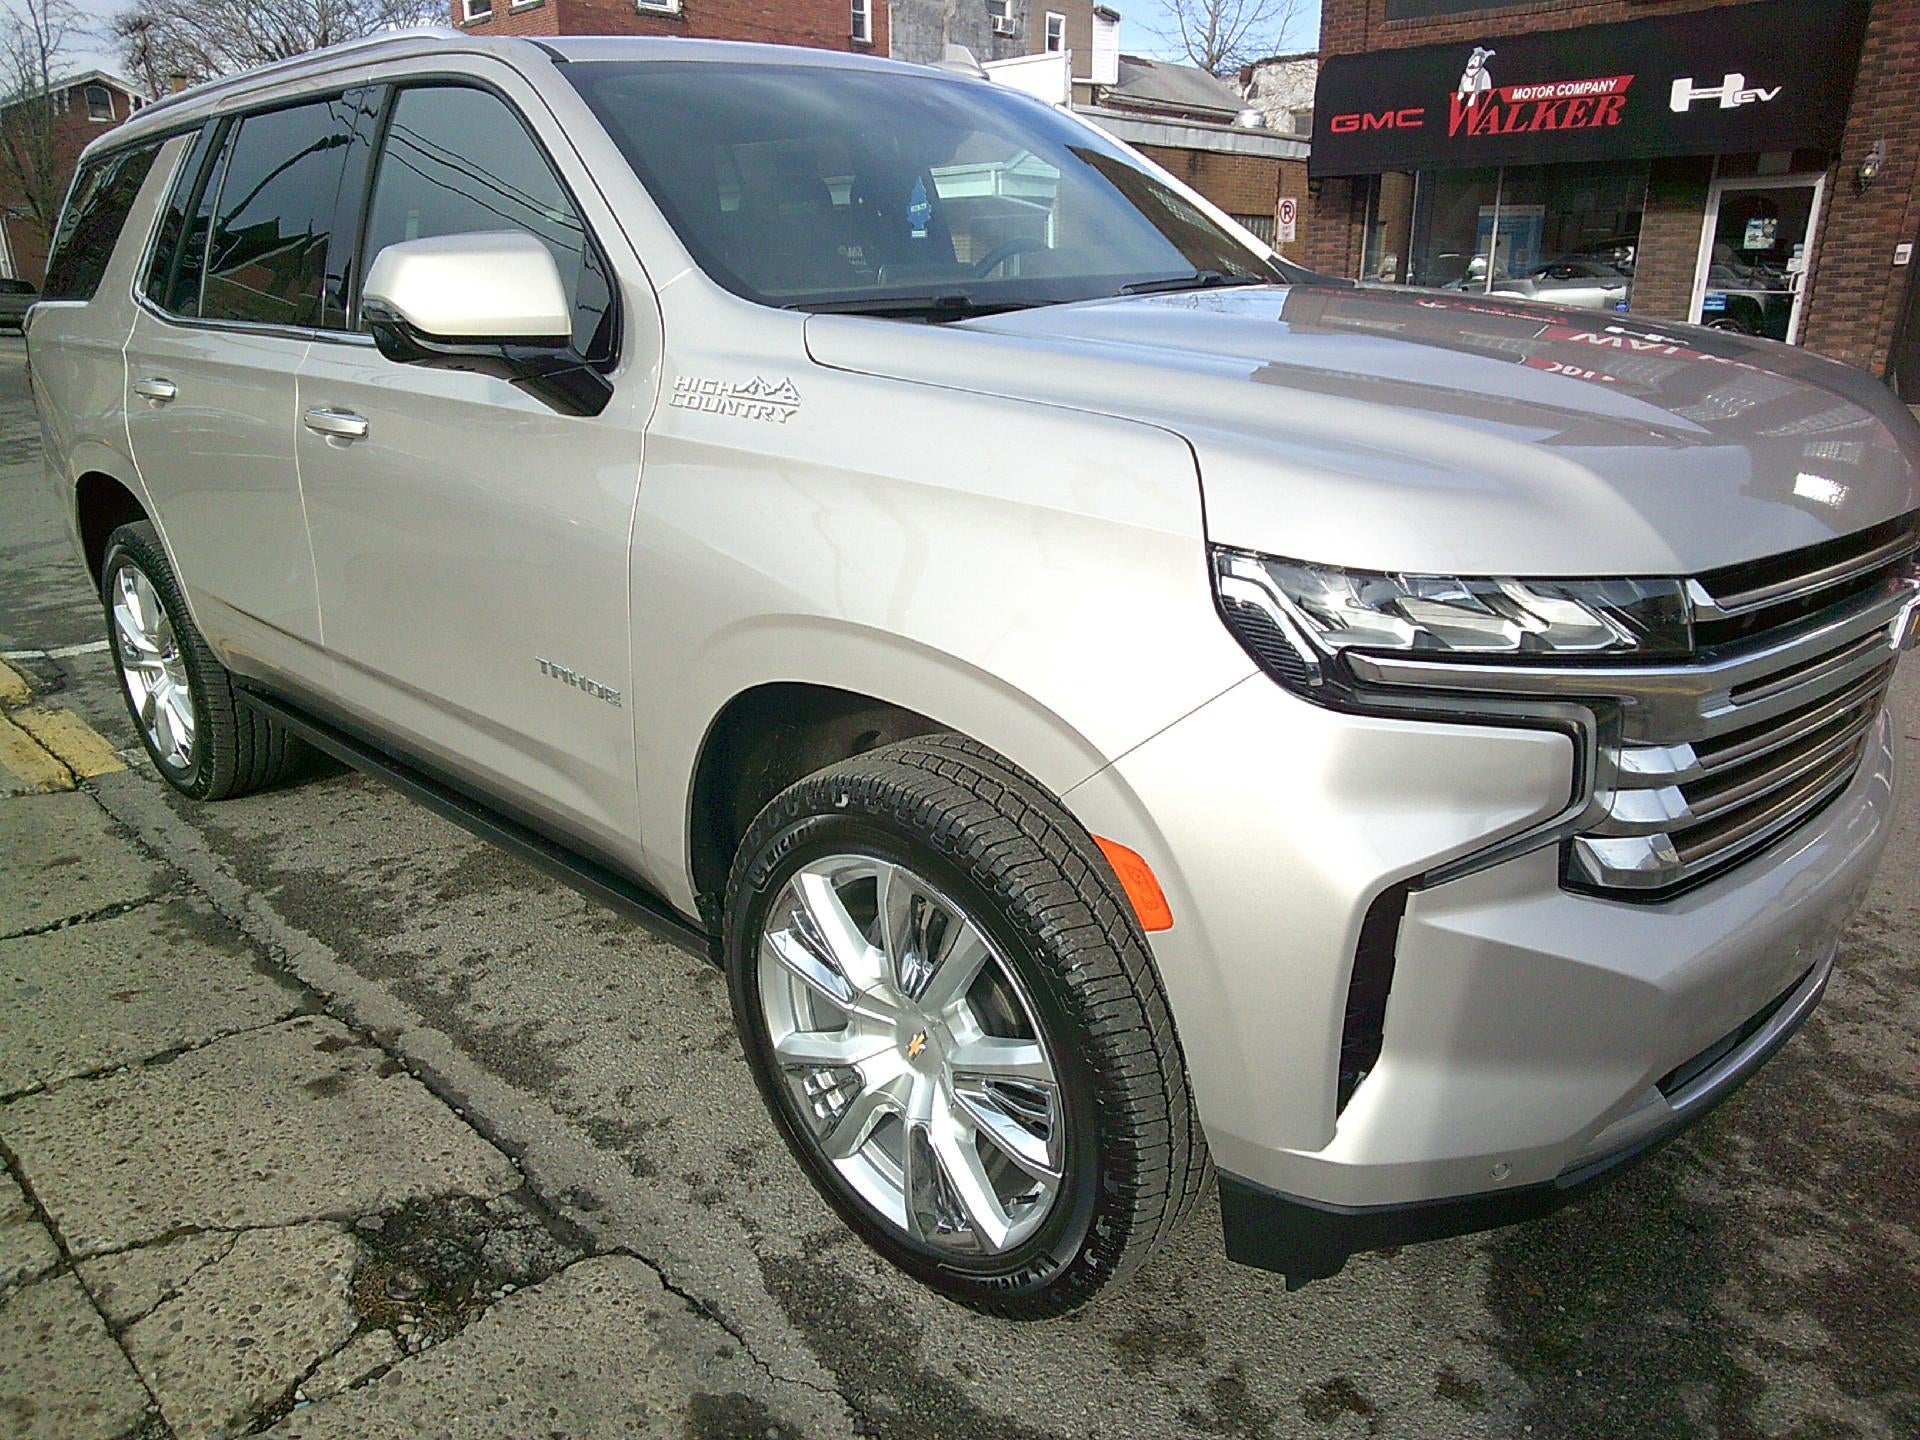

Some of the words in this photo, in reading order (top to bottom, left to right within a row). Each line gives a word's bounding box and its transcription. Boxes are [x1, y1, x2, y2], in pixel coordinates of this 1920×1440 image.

[1511, 85, 1555, 100] MOTOR
[1556, 79, 1618, 98] COMPANY
[1330, 108, 1425, 134] GMC
[1448, 88, 1627, 137] WALKER
[673, 375, 739, 396] HIGH
[669, 394, 798, 424] COUNTRY
[535, 656, 622, 707] TAHOE
